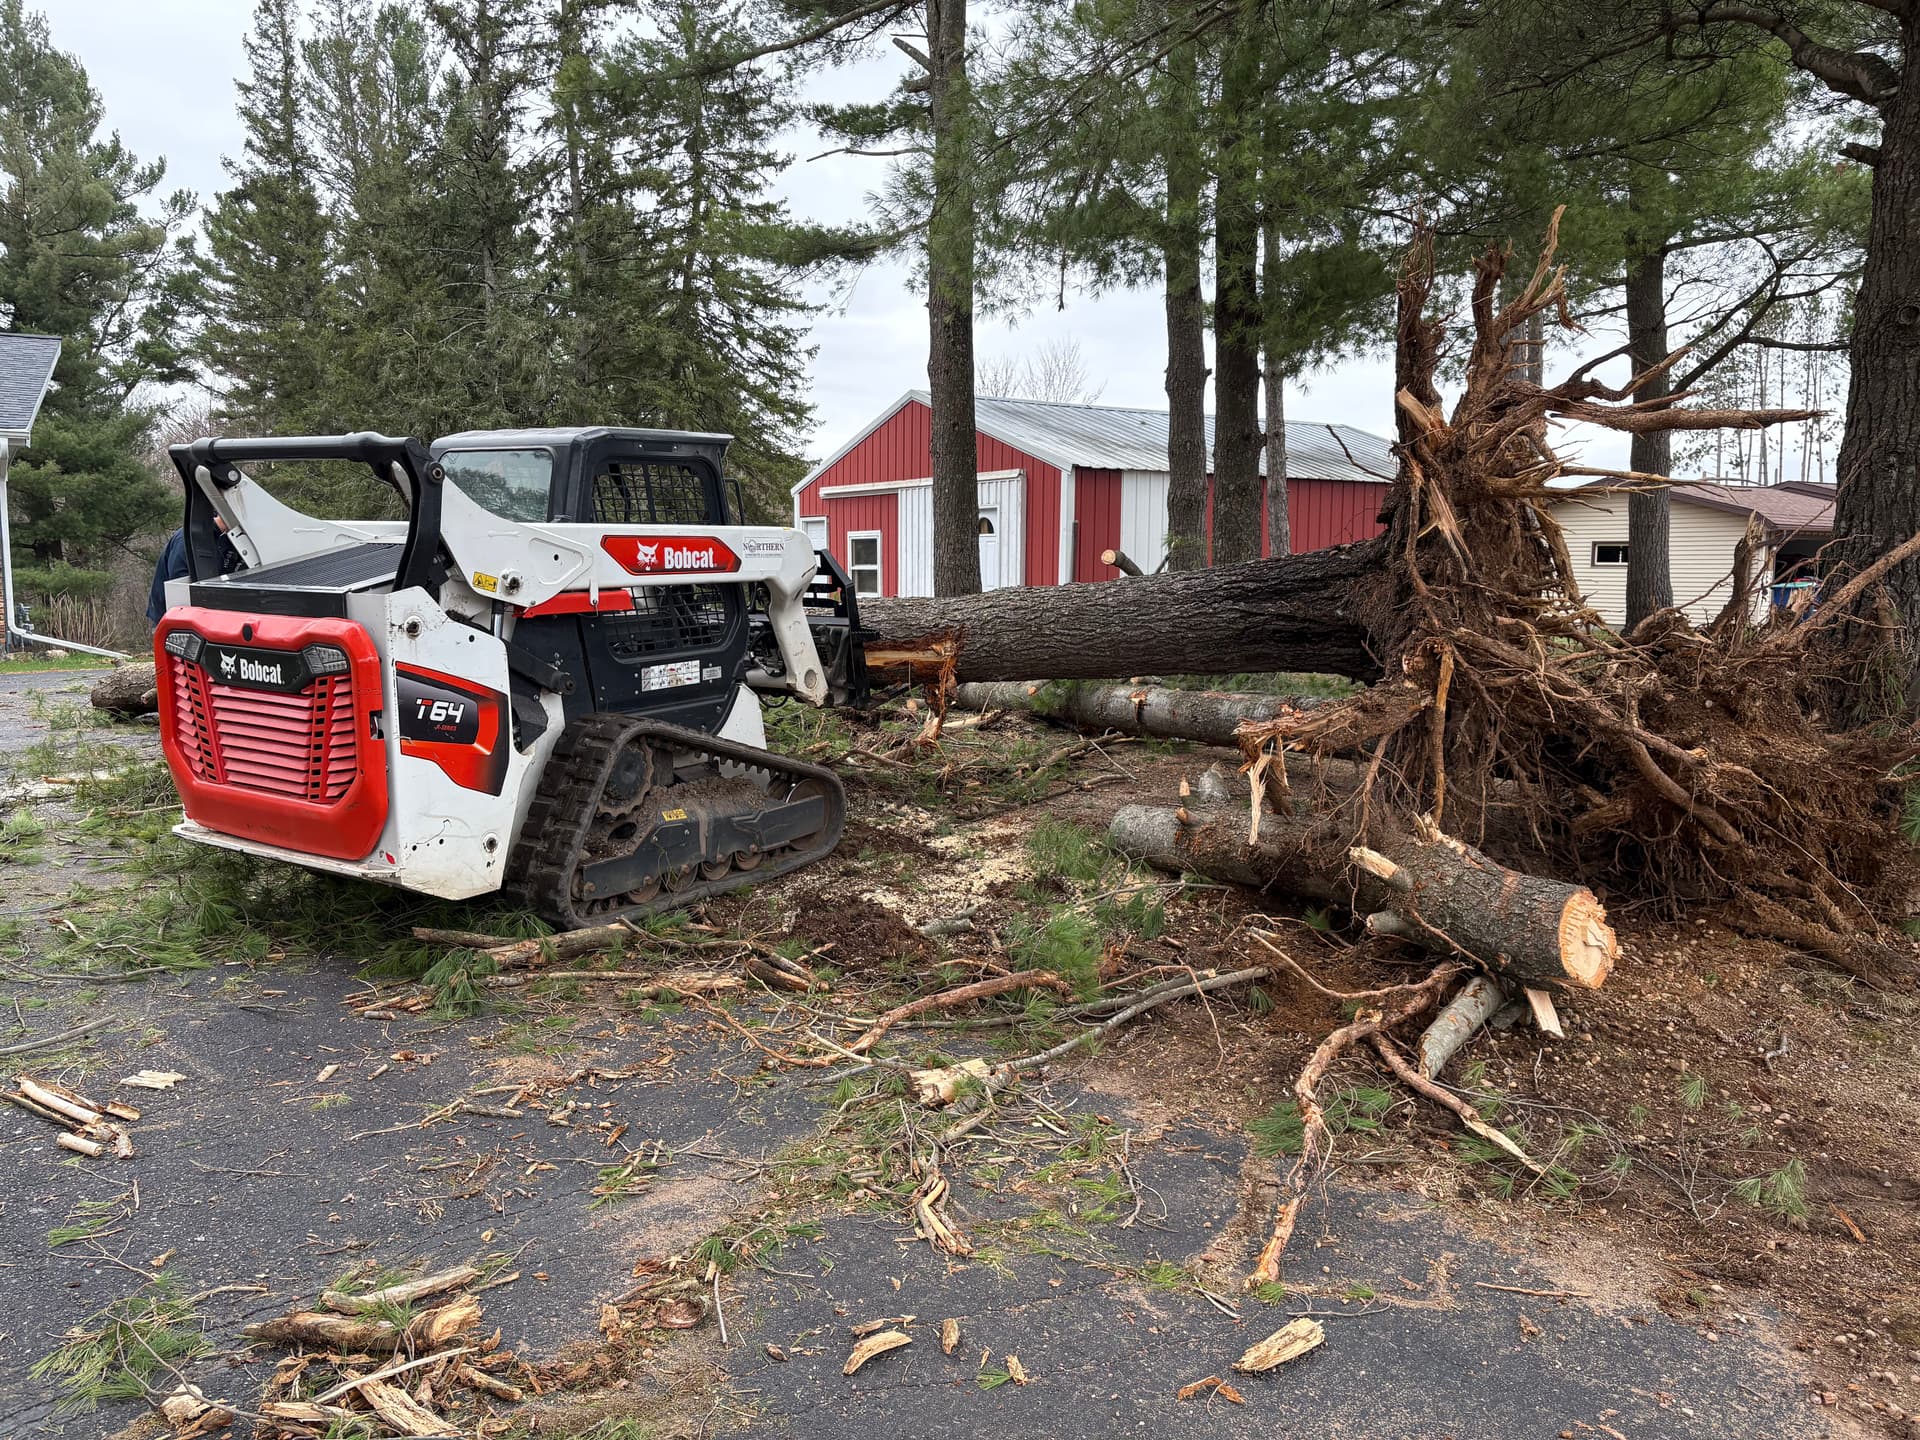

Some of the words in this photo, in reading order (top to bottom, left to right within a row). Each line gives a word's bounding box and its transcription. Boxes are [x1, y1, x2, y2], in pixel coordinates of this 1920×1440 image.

[664, 547, 714, 569] Bobcat
[240, 658, 282, 684] Bobcat
[416, 698, 464, 723] T64
